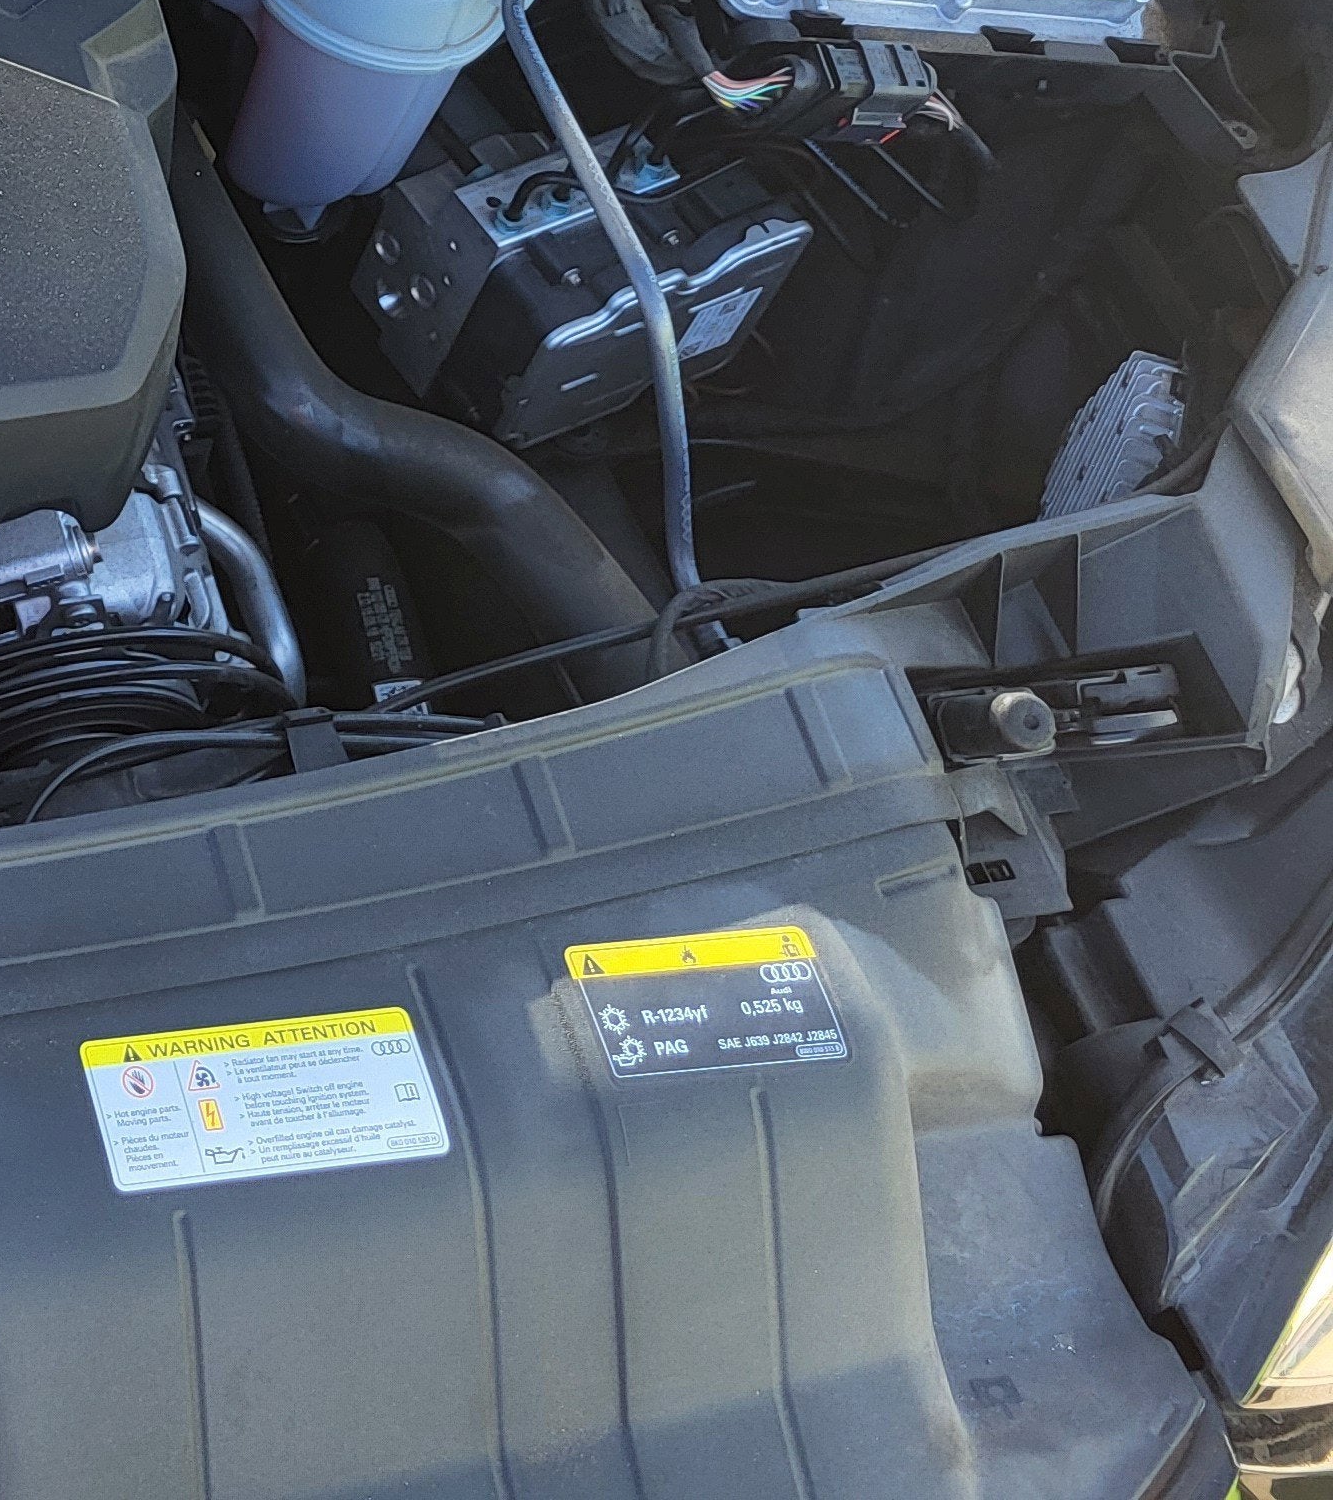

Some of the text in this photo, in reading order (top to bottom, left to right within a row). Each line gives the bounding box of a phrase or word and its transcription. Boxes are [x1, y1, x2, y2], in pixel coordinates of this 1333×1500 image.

[769, 985, 792, 995] Audi
[640, 995, 804, 1027] R-1234yf 0,525 kg
[147, 1019, 376, 1059] WARNING ATTENTION
[652, 1038, 689, 1055] PAG
[717, 1028, 838, 1049] SAE J639 J2842 J2845
[231, 1056, 265, 1066] Radiator
[279, 1053, 297, 1062] may
[298, 1050, 317, 1058] start
[326, 1048, 342, 1056] any
[233, 1067, 244, 1075] Le
[245, 1062, 287, 1073] ventilateur
[288, 1061, 307, 1069] peut
[241, 1091, 261, 1101] High
[295, 1084, 323, 1094] Switch
[322, 1082, 335, 1090] off
[335, 1080, 363, 1091] engine
[244, 1099, 270, 1109] before
[271, 1095, 306, 1107] touching
[306, 1091, 338, 1103] ignition
[247, 1108, 271, 1118] Haute
[341, 1097, 370, 1106] moteur
[113, 1109, 129, 1118] Hot
[129, 1106, 157, 1117] engine
[249, 1118, 272, 1126] avant
[284, 1112, 315, 1122] toucher
[116, 1114, 171, 1128] Moving parts.
[148, 1133, 159, 1141] du
[160, 1130, 189, 1140] moteur
[255, 1133, 295, 1144] Overfilled
[295, 1130, 323, 1141] engine
[323, 1128, 335, 1136] oil
[350, 1122, 384, 1134] damage
[258, 1145, 271, 1153] Un
[271, 1139, 320, 1153] remplissage
[260, 1154, 279, 1164] peut
[279, 1151, 301, 1160] nuire
